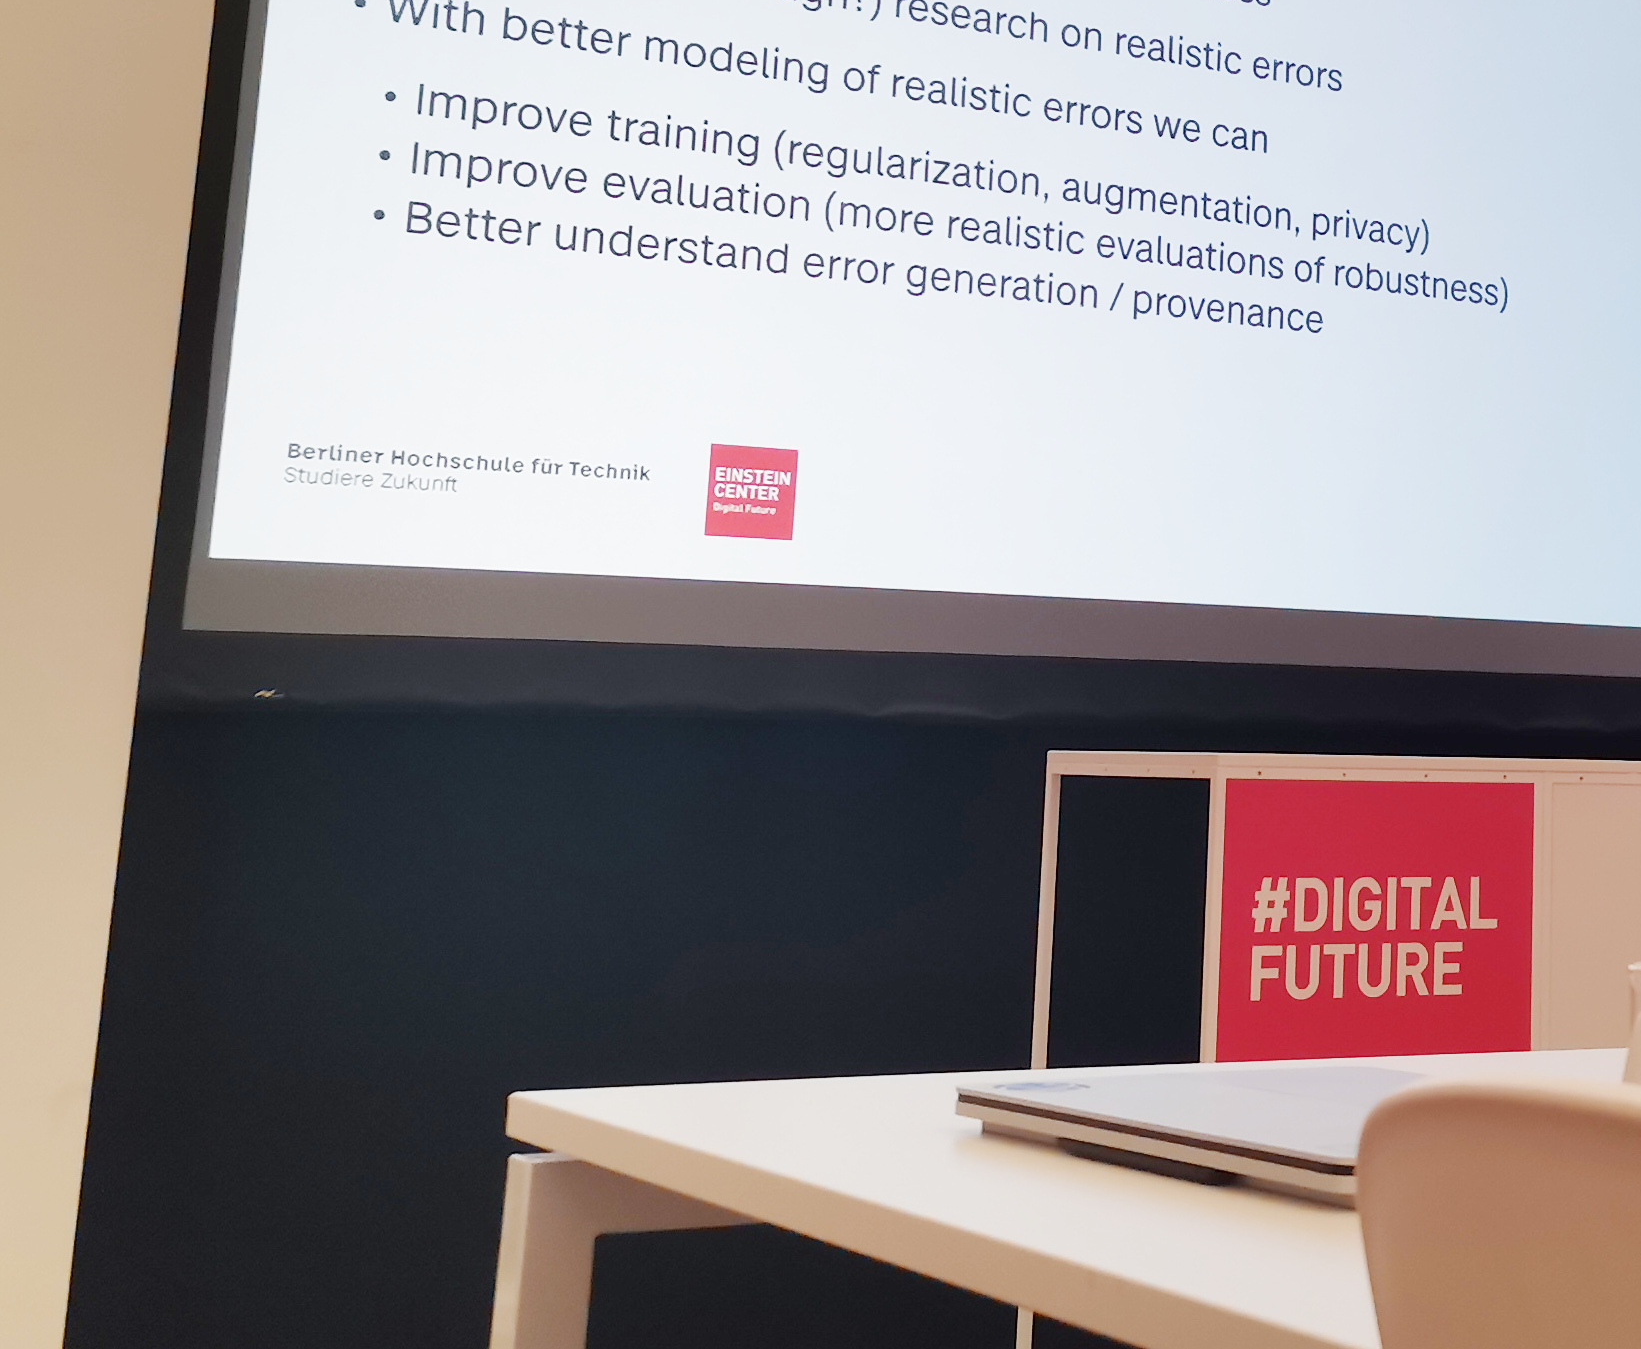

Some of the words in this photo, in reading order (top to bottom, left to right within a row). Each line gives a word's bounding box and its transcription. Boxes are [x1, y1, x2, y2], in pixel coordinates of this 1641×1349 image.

[502, 6, 632, 57] better
[644, 35, 829, 94] modeling
[843, 63, 883, 95] of
[891, 73, 1032, 118] realistic
[1043, 97, 1143, 135] errors
[1153, 113, 1201, 143] we
[1212, 123, 1268, 154] can
[1060, 23, 1102, 52] on
[1115, 31, 1242, 75] realistic
[1252, 56, 1343, 92] errors
[416, 83, 593, 138] Improve
[607, 109, 760, 167] training
[774, 129, 1049, 204] (regularization,
[1062, 178, 1300, 238] augmentation,
[1311, 208, 1430, 256] privacy)
[411, 141, 588, 194] Improve
[602, 172, 810, 222] evaluation
[824, 190, 934, 237] (more
[947, 215, 1086, 255] realistic
[1096, 234, 1284, 280] evaluations
[1294, 255, 1327, 285] of
[1334, 262, 1509, 314] robustness)
[405, 200, 542, 247] Better
[554, 223, 790, 275] understand
[803, 252, 896, 286] error
[906, 264, 1098, 309] generation
[1108, 281, 1125, 312] /
[1132, 289, 1324, 334] provenance
[283, 466, 375, 489] Studiere
[380, 472, 459, 494] Zukunft
[286, 442, 384, 465] Berliner
[390, 448, 525, 474] Hochschule
[531, 457, 564, 476] für
[568, 460, 652, 482] Technik
[713, 482, 780, 501] CENTER
[715, 466, 792, 486] EINSTEIN
[1251, 876, 1499, 933] #DIGITAL
[1249, 941, 1464, 1002] FUTURE
